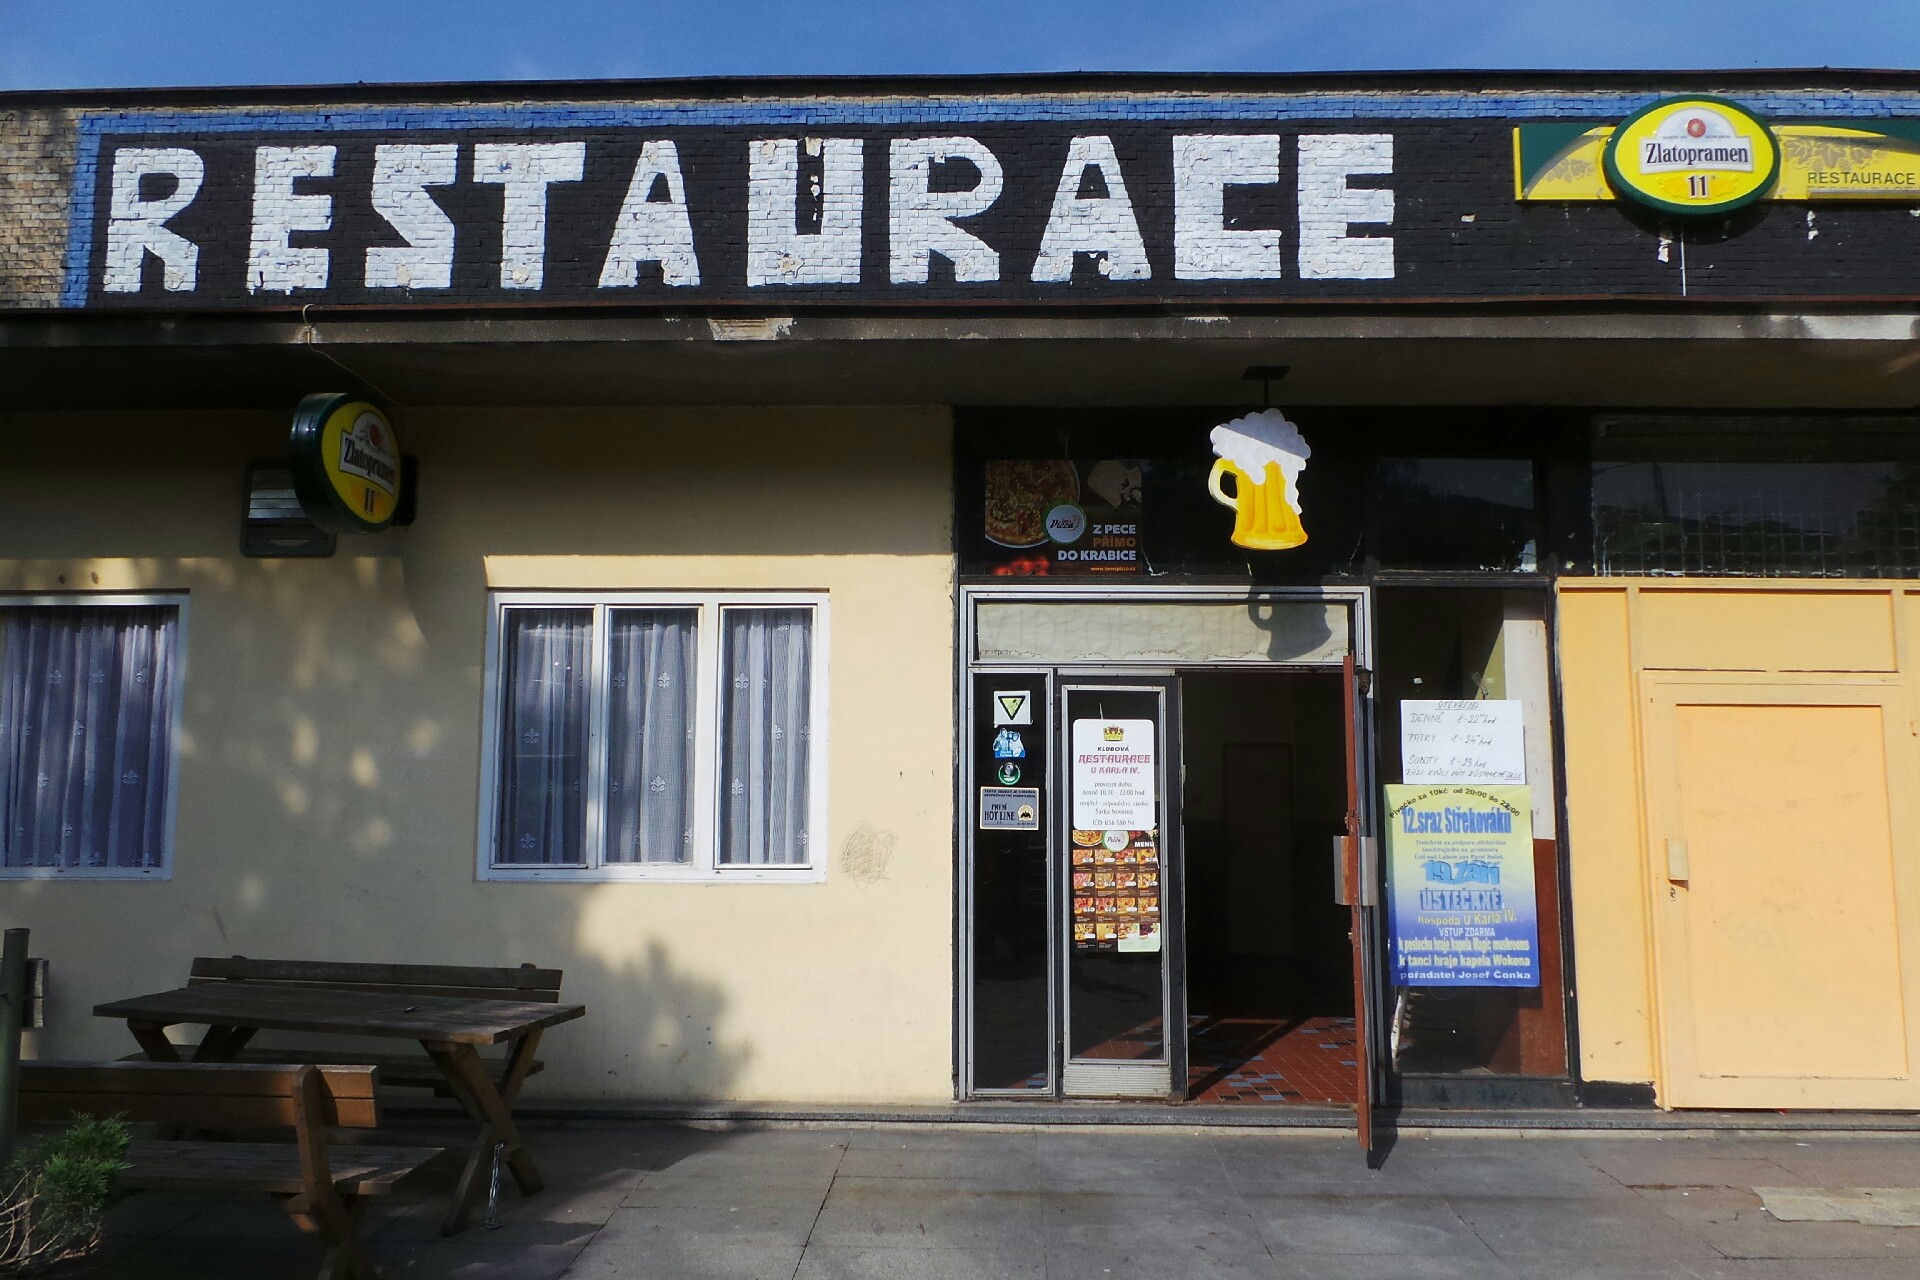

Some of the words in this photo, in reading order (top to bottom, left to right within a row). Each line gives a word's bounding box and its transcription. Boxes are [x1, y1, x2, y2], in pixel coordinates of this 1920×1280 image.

[1646, 142, 1748, 165] Zlatopramen
[1808, 172, 1916, 184] RESTAURACE
[103, 134, 1396, 294] RESTAURACE
[344, 438, 395, 486] Zlatopramen
[1050, 520, 1074, 528] Pizza
[1093, 524, 1102, 534] Z
[1104, 524, 1136, 534] PECE
[1093, 535, 1136, 547] PŘÍMO
[1058, 550, 1078, 560] DO
[1080, 550, 1136, 560] KRABICE
[1437, 701, 1480, 709] OTEVŘENO
[1410, 712, 1444, 723] DENNĚ
[1408, 730, 1436, 742] PÁTKY
[1078, 755, 1150, 764] RESTAURACE
[1408, 754, 1439, 764] SOBOTY
[1388, 798, 1416, 818] Pivečko
[1429, 788, 1448, 796] 10kč
[1465, 788, 1487, 798] 20:00
[1489, 793, 1499, 803] do
[1401, 807, 1442, 834] 12.sraz
[1444, 806, 1512, 834] Střekováku
[1418, 915, 1460, 926] hospoda
[1463, 914, 1471, 925] U
[1474, 911, 1501, 924] Karla
[1503, 909, 1516, 922] IV.
[1439, 928, 1463, 936] VSTUP
[1465, 928, 1495, 936] ZDARMA
[1399, 955, 1406, 966] k
[1408, 955, 1431, 966] tanci
[1434, 955, 1458, 968] hraje
[1460, 955, 1491, 968] kapela
[1493, 955, 1530, 966] Wokena
[1400, 971, 1455, 980] pořadatel
[1494, 969, 1531, 979] Čonka
